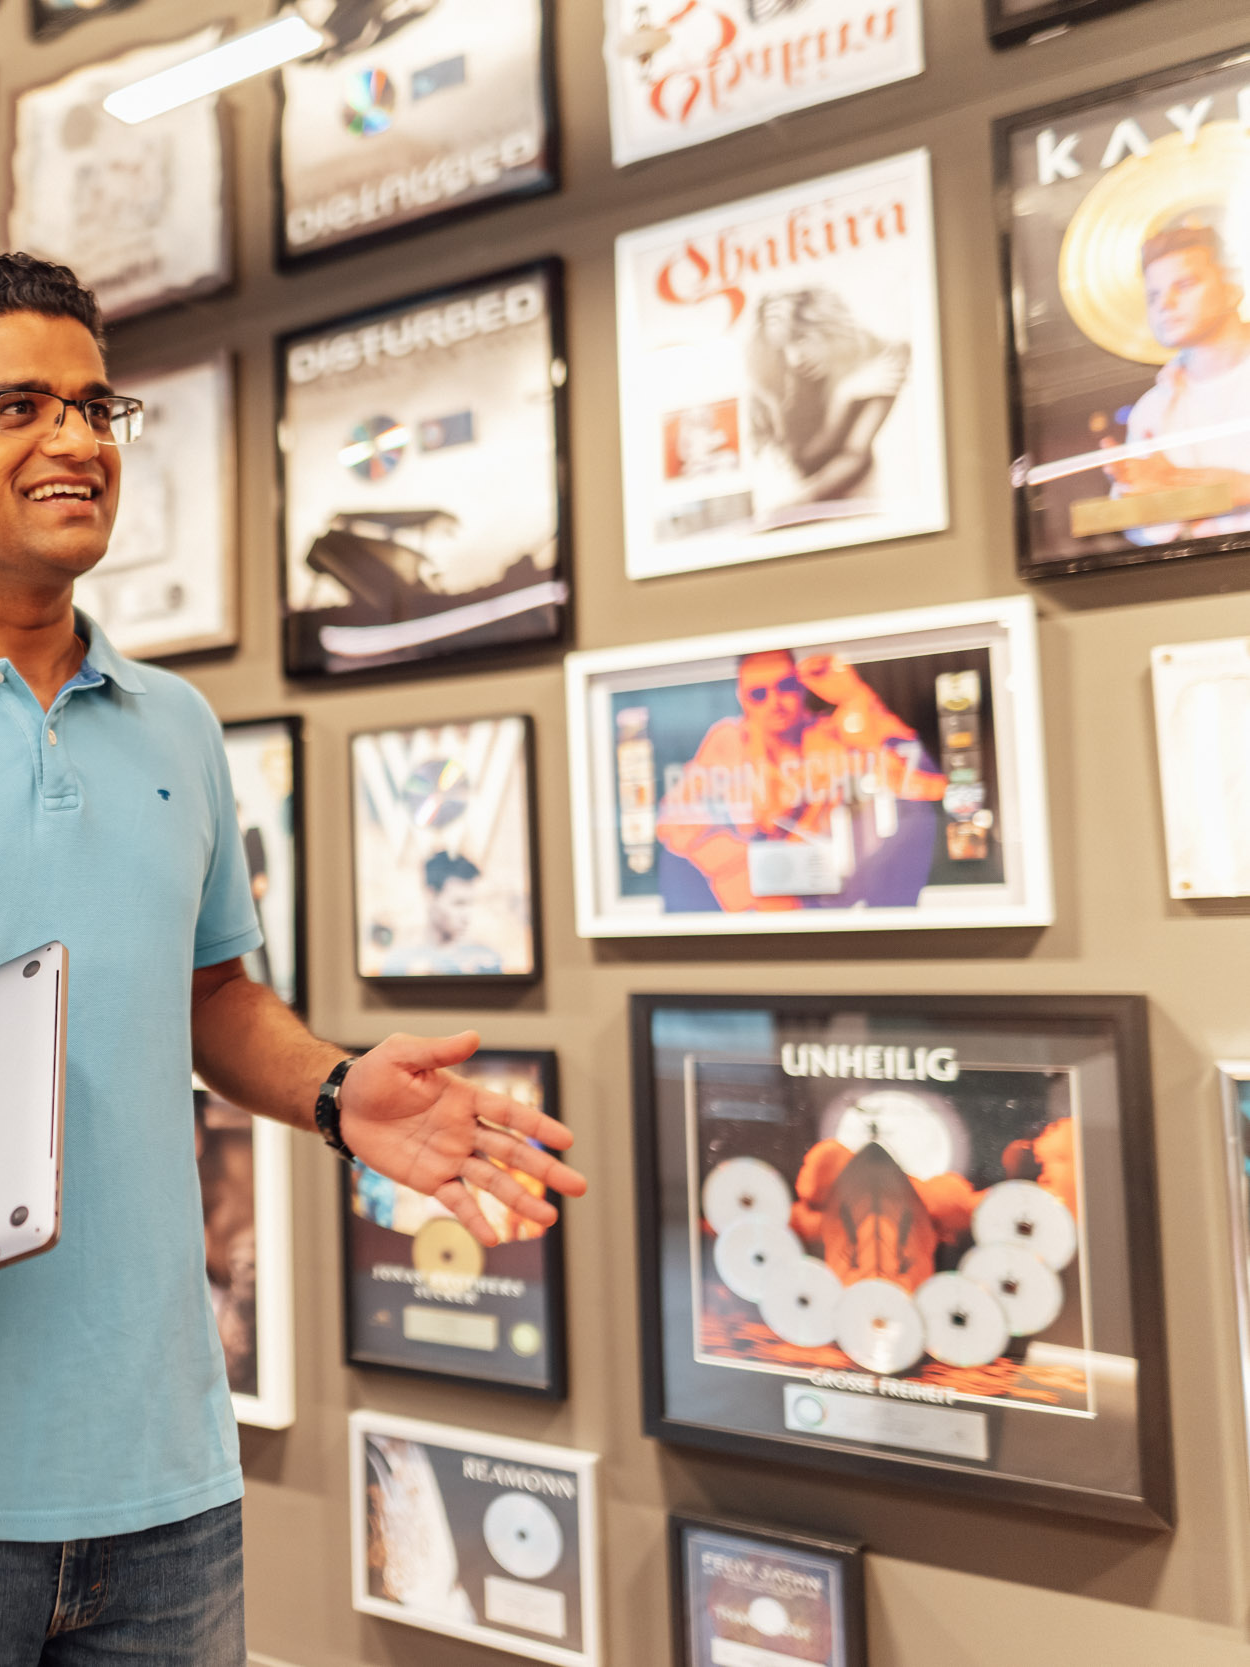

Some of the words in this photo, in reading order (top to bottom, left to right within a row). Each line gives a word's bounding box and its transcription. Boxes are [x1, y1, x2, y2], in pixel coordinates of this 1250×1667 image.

[1036, 86, 1250, 186] KAY
[655, 199, 907, 328] Shakira
[287, 282, 544, 385] DISTURBED
[663, 760, 767, 813] ROBIN
[779, 741, 924, 806] SCHULZ
[781, 1043, 959, 1081] UNHEILIG
[462, 1456, 576, 1500] REAMONN
